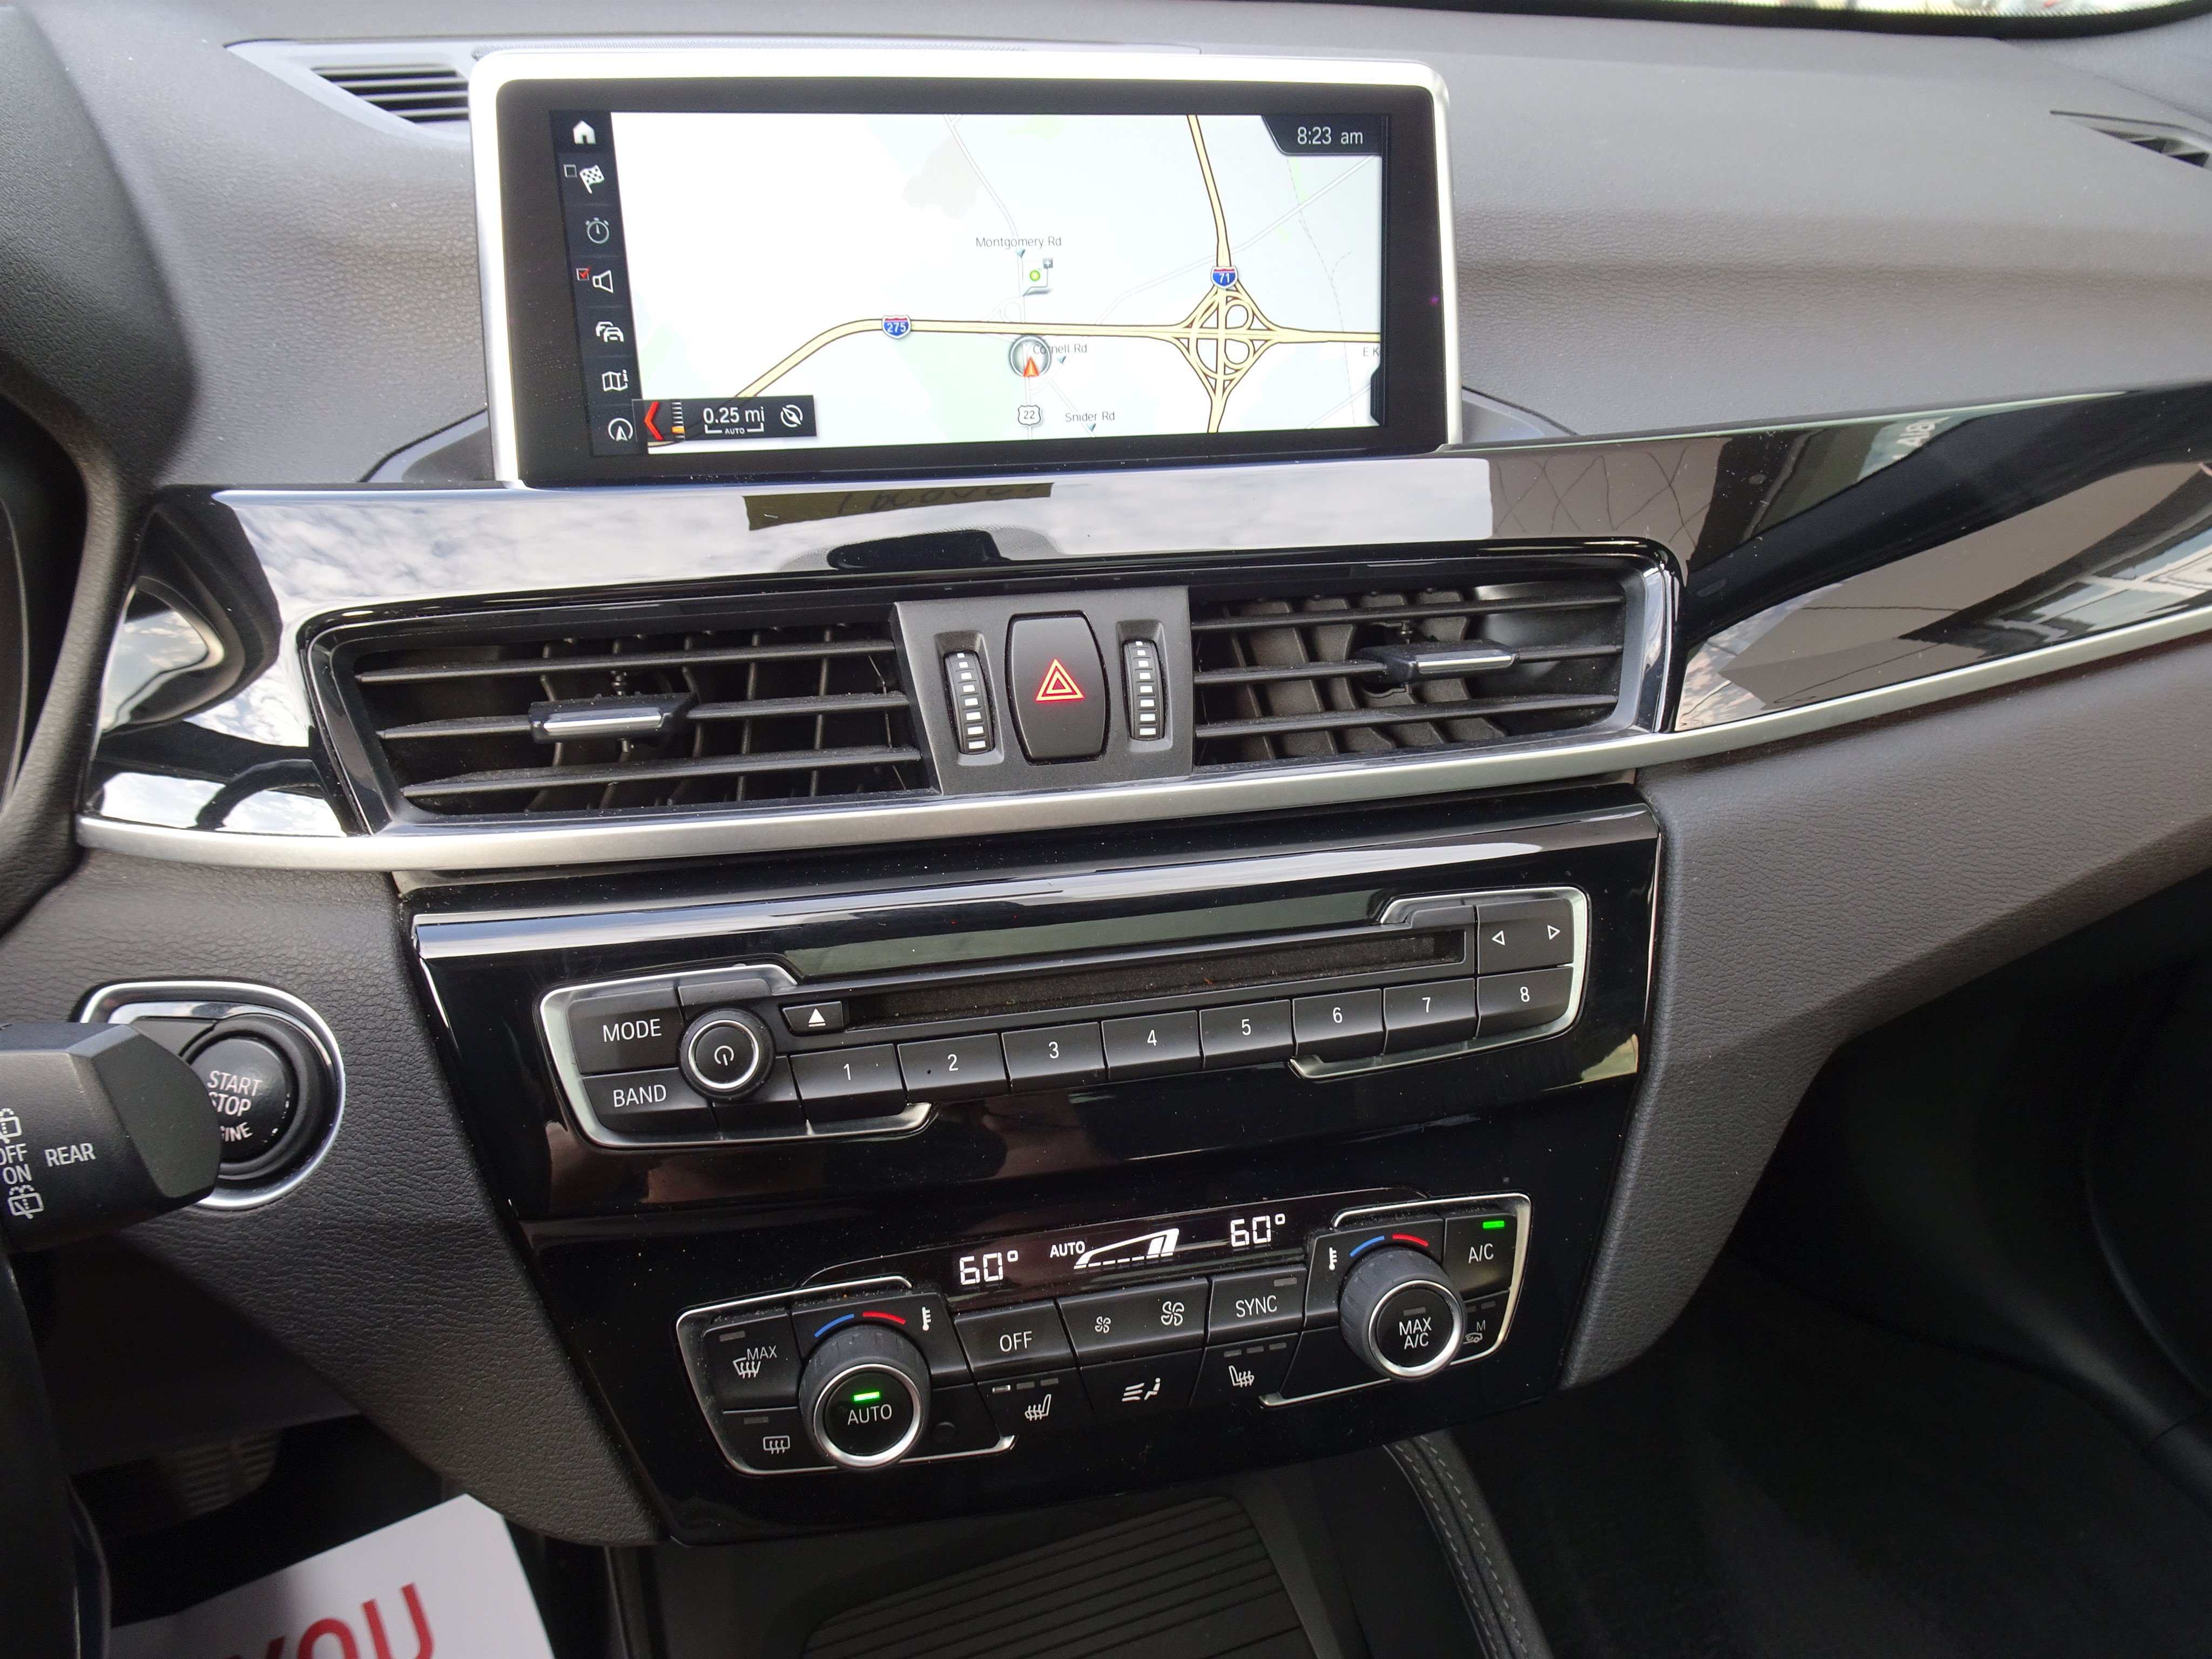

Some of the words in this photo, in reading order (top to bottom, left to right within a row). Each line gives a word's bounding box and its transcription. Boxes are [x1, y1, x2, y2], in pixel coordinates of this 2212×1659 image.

[1297, 127, 1332, 145] 8:23
[1341, 130, 1363, 144] am
[976, 237, 1043, 249] Montgomery
[1048, 236, 1061, 246] Rd
[1219, 273, 1230, 284] 71
[887, 321, 906, 333] 275
[1033, 344, 1069, 354] Conell
[1075, 343, 1087, 353] Rd
[703, 408, 740, 424] 0.25
[745, 407, 765, 422] mi
[1023, 409, 1035, 420] 22
[1065, 411, 1096, 423] Snider
[1102, 411, 1115, 421] Rd
[1520, 986, 1530, 1002] 8
[1422, 997, 1431, 1013] 7
[1333, 1007, 1343, 1024] 6
[603, 1018, 662, 1042] MODE
[1242, 1019, 1251, 1036] 5
[1147, 1029, 1157, 1047] 4
[1049, 1042, 1060, 1058] 3
[948, 1054, 959, 1071] 2
[844, 1063, 852, 1080] 1
[207, 1070, 263, 1096] START
[613, 1084, 667, 1108] BAND
[44, 1143, 96, 1166] REAR
[2, 1164, 32, 1185] ON
[1049, 1241, 1085, 1258] AUTO
[1468, 1243, 1494, 1264] A/C
[1235, 1296, 1277, 1318] SYNC
[1399, 1317, 1432, 1336] MAX
[999, 1331, 1033, 1352] OFF
[1404, 1333, 1429, 1350] A/C
[747, 1345, 778, 1361] MAX
[847, 1404, 893, 1426] AUTO
[222, 1582, 435, 1659] OU
